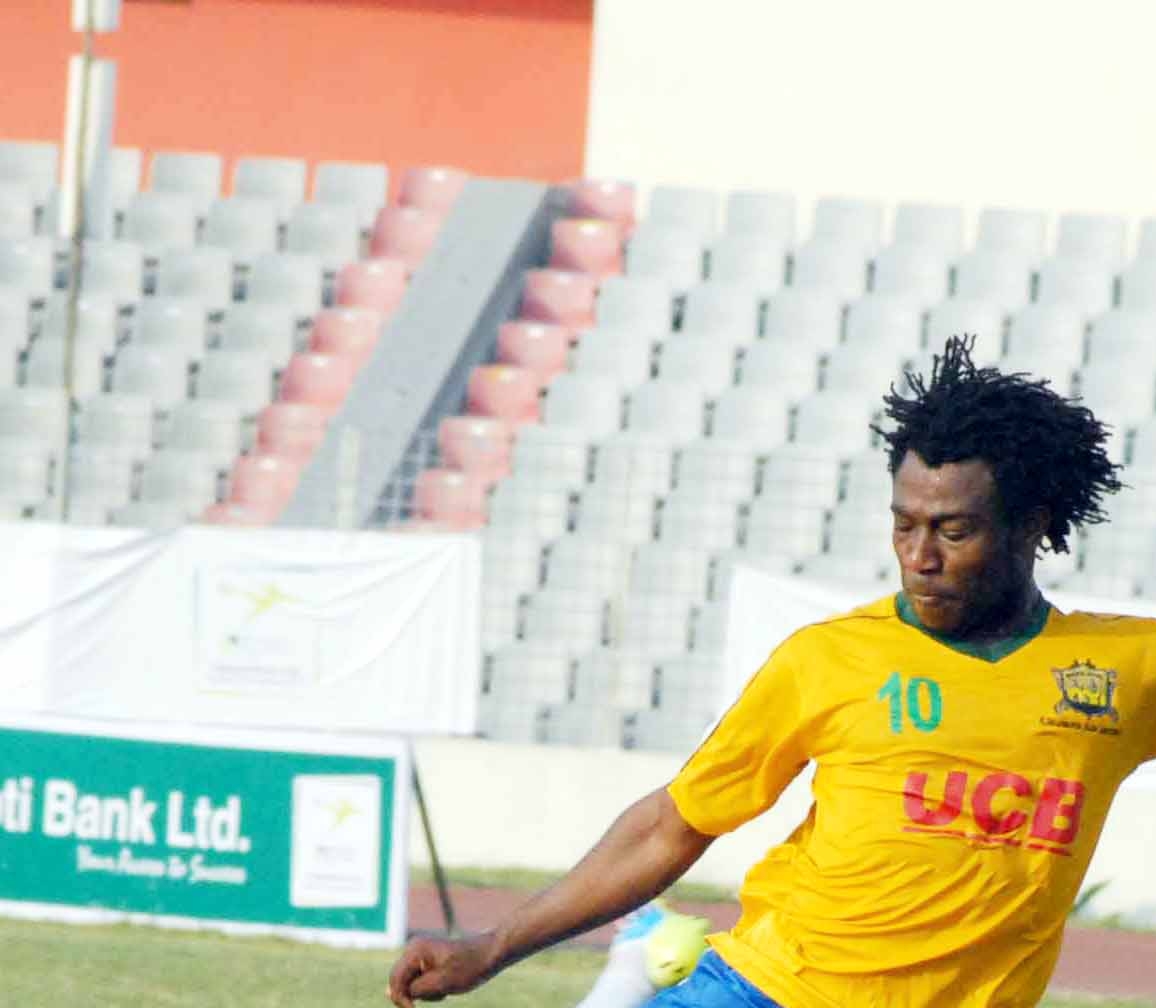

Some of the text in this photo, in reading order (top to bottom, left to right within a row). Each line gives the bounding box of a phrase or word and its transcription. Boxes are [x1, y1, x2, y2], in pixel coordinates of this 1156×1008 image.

[878, 671, 942, 734] 10
[43, 779, 157, 845] Bank
[166, 790, 251, 853] Ltd.
[903, 771, 1086, 845] UCB
